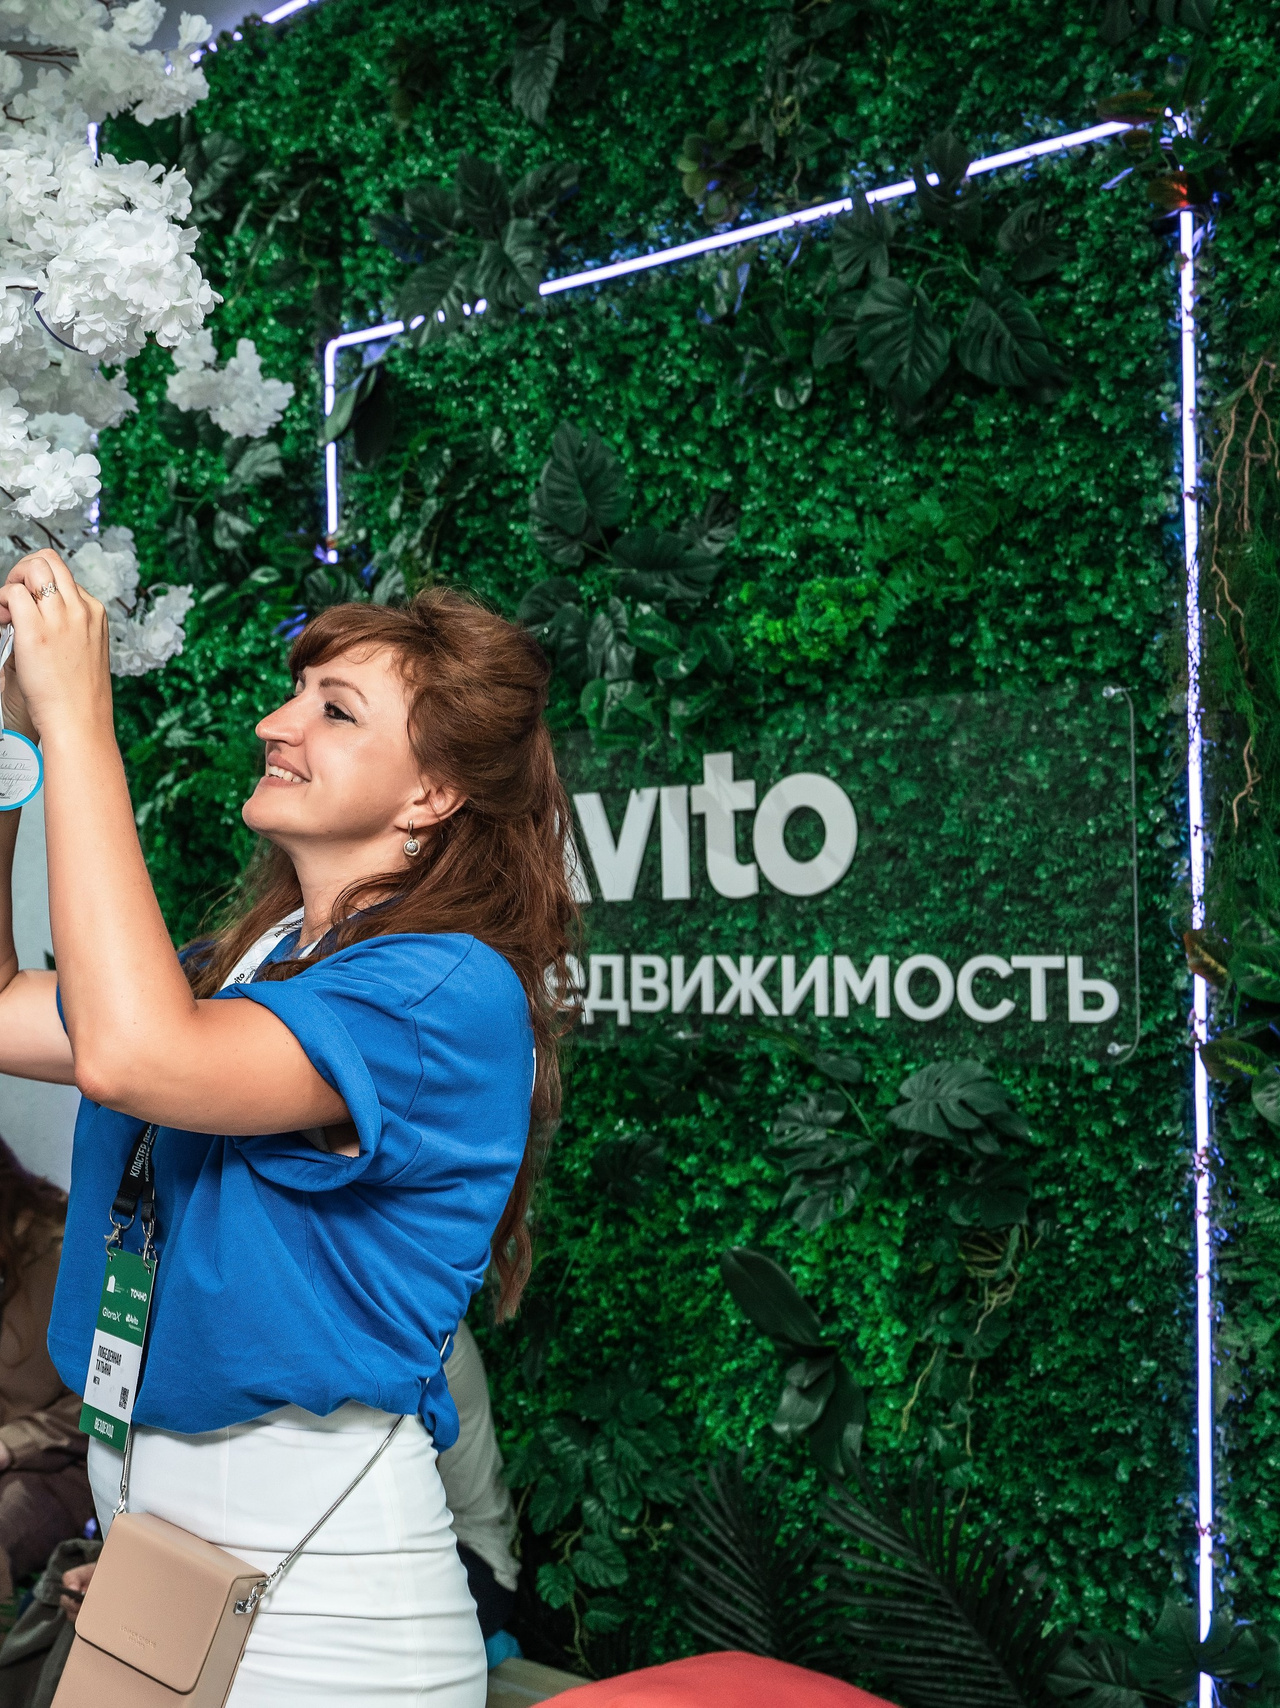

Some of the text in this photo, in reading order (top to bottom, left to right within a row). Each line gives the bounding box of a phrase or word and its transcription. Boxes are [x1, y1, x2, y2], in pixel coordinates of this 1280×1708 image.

[555, 752, 858, 902] vito
[542, 953, 1120, 1027] едвижимость
[130, 1144, 147, 1177] КЛАСТЕР
[102, 1307, 121, 1322] GloraX
